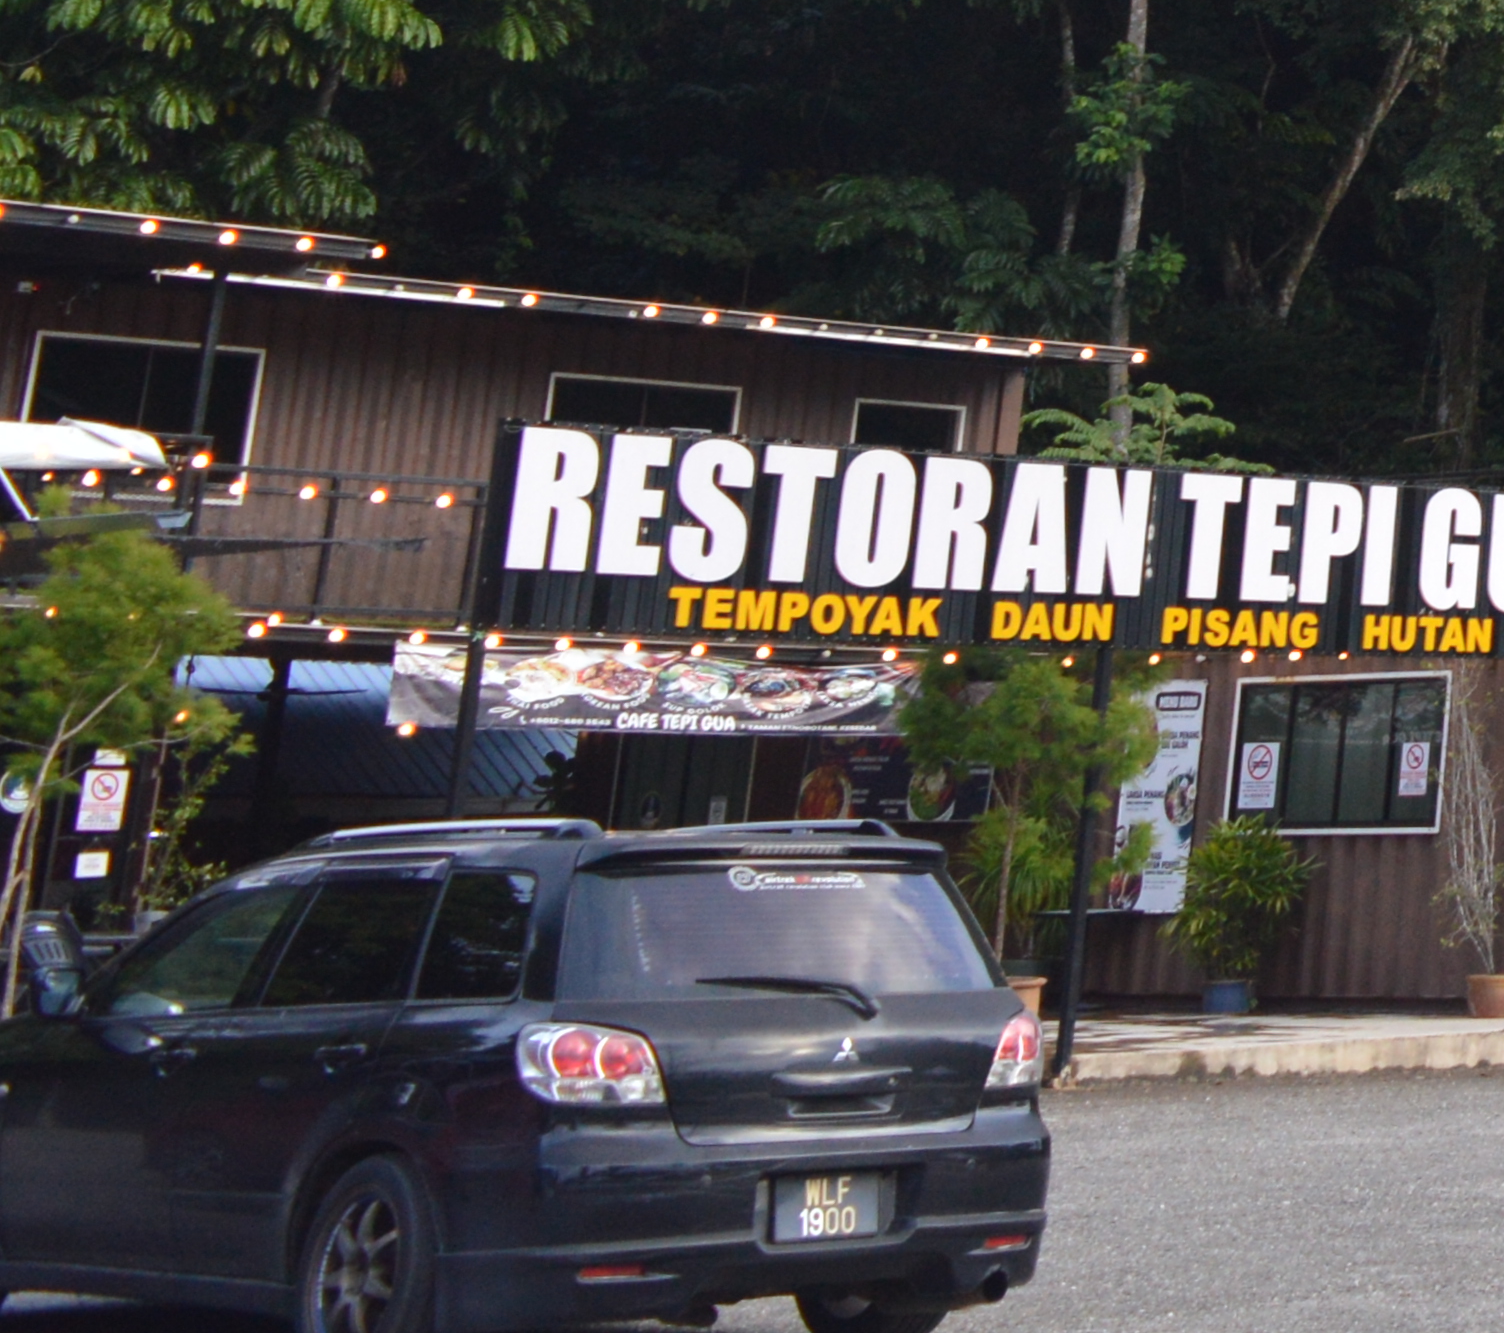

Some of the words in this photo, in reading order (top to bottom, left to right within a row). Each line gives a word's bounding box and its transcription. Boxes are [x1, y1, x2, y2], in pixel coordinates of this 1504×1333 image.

[504, 426, 1152, 597] RESTORAN
[1180, 473, 1398, 606] TEPI
[668, 587, 943, 638] TEMPOYAK
[991, 601, 1114, 642] DAUN
[1161, 607, 1319, 649] PISANG
[1362, 614, 1493, 653] HUTAN
[533, 697, 565, 710] FOOD
[662, 701, 684, 712] SUP
[617, 712, 658, 729] CAFE
[661, 715, 697, 730] TEPI
[701, 715, 736, 731] GUA
[806, 1176, 851, 1206] WLF
[799, 1206, 856, 1236] 1900
